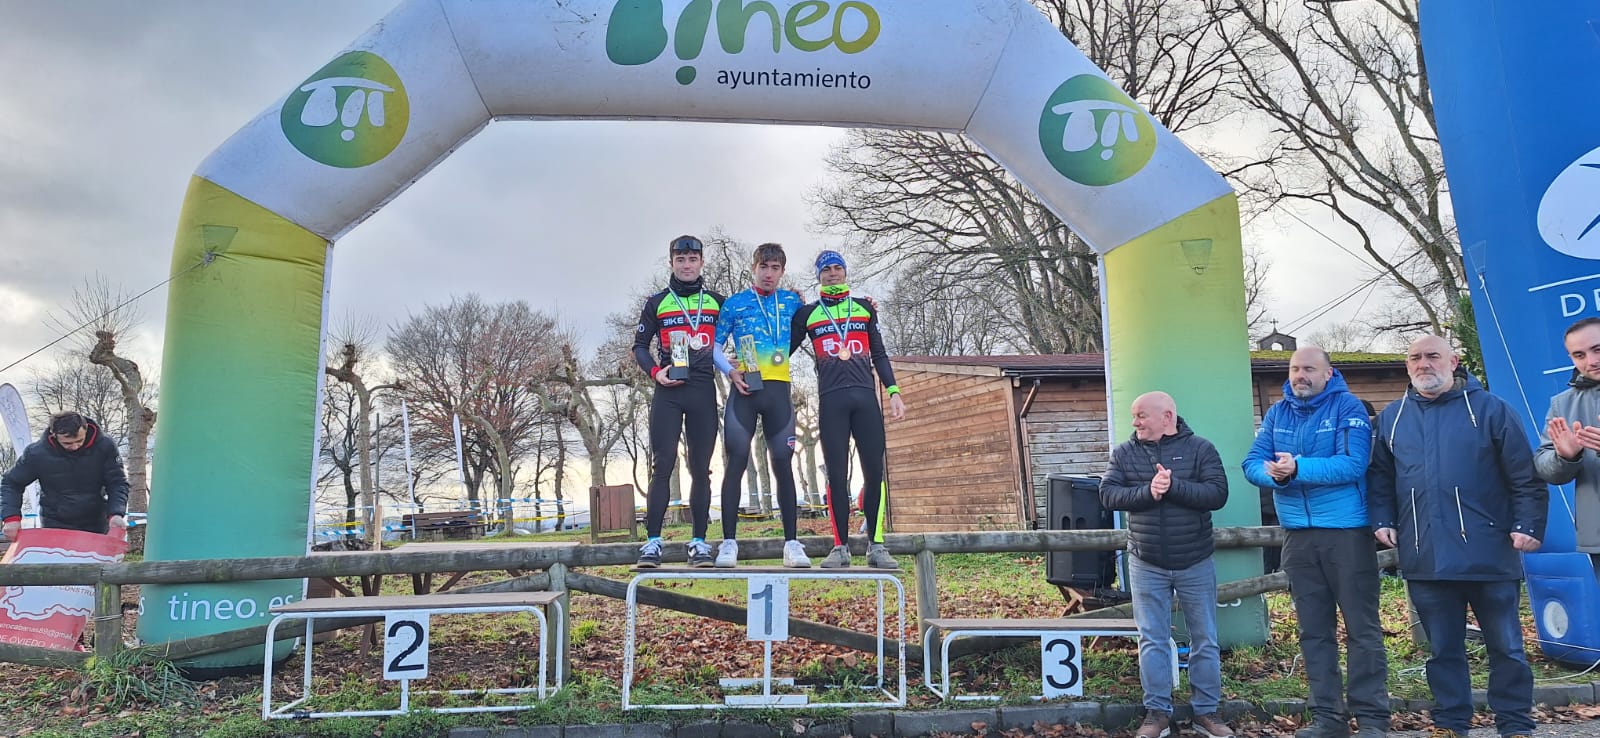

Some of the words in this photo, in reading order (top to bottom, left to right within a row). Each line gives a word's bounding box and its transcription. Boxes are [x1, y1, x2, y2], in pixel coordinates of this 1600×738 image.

[717, 68, 871, 89] ayuntamiento
[752, 584, 773, 636] 1
[388, 620, 424, 673] 2
[1045, 639, 1079, 689] 3
